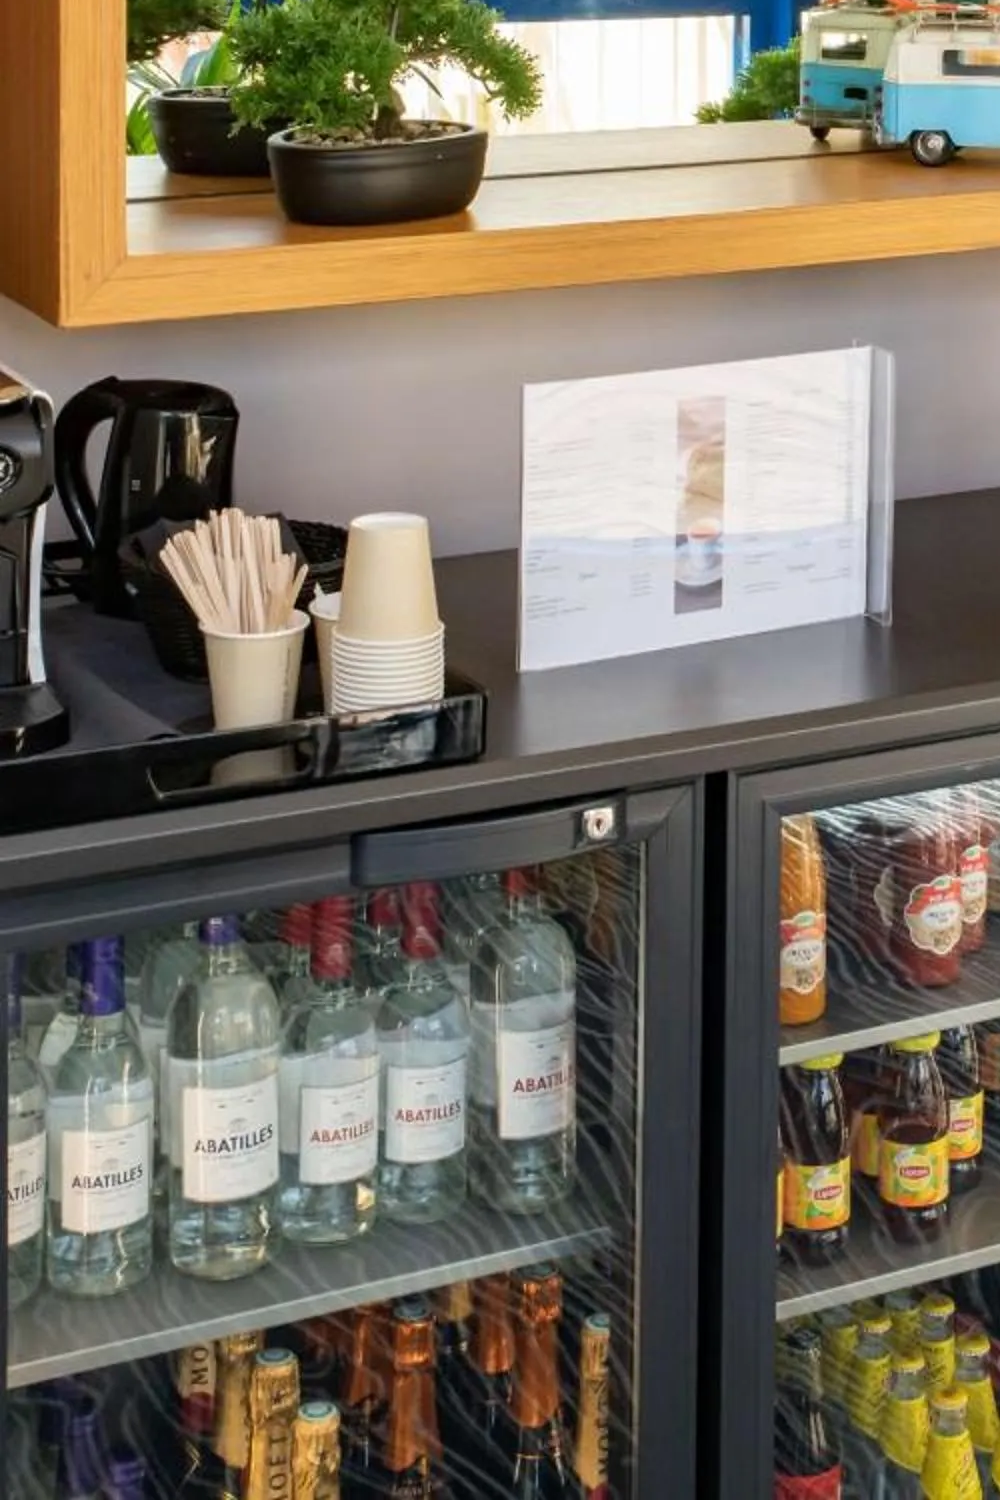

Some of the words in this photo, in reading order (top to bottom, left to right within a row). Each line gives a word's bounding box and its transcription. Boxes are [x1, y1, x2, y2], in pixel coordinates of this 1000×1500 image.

[394, 1100, 462, 1123] ABATILLES
[193, 1123, 274, 1154] ABATILLES
[310, 1117, 375, 1143] ABATILLES
[71, 1162, 144, 1189] ABATILLES
[190, 1346, 209, 1385] MO
